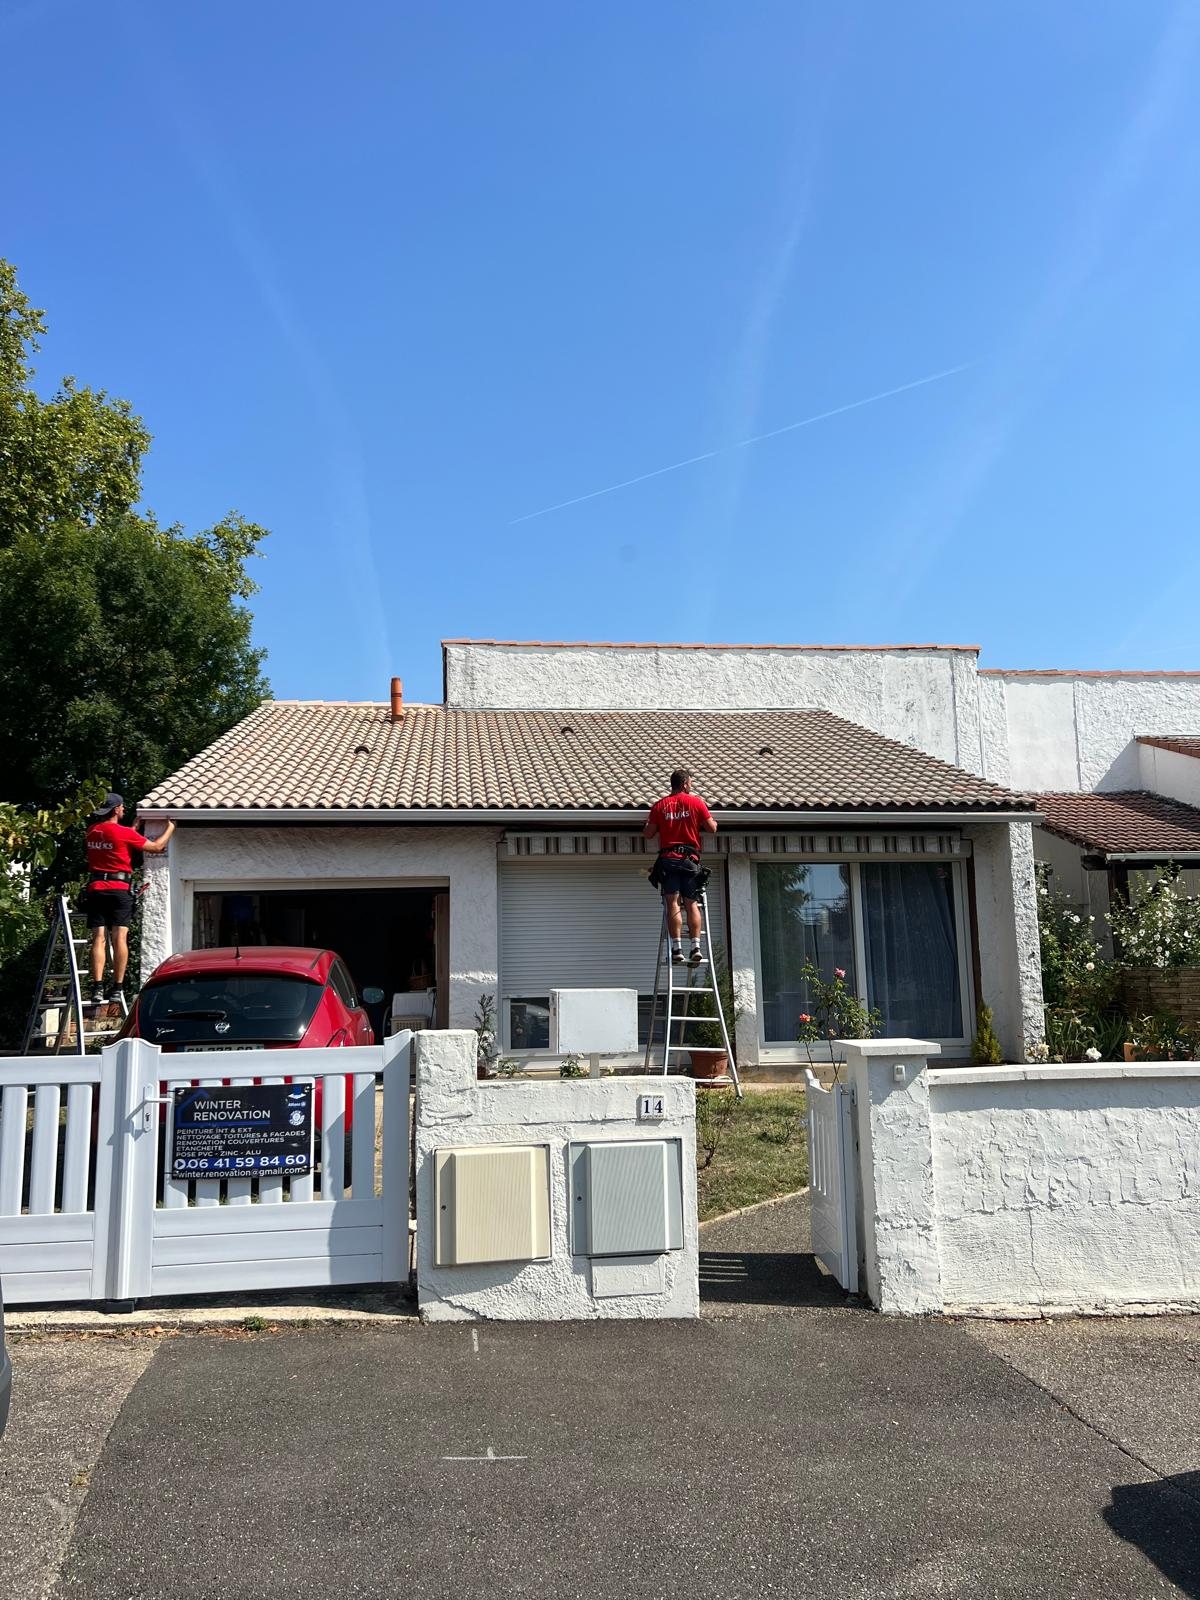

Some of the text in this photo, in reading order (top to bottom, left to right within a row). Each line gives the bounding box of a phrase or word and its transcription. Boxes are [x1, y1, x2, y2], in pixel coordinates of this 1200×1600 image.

[194, 1100, 241, 1110] WINTER
[644, 1099, 663, 1113] 14
[193, 1110, 271, 1121] RENOVATION
[227, 1137, 285, 1145] COUVERTURES
[188, 1154, 306, 1169] 06 41 59 84 60
